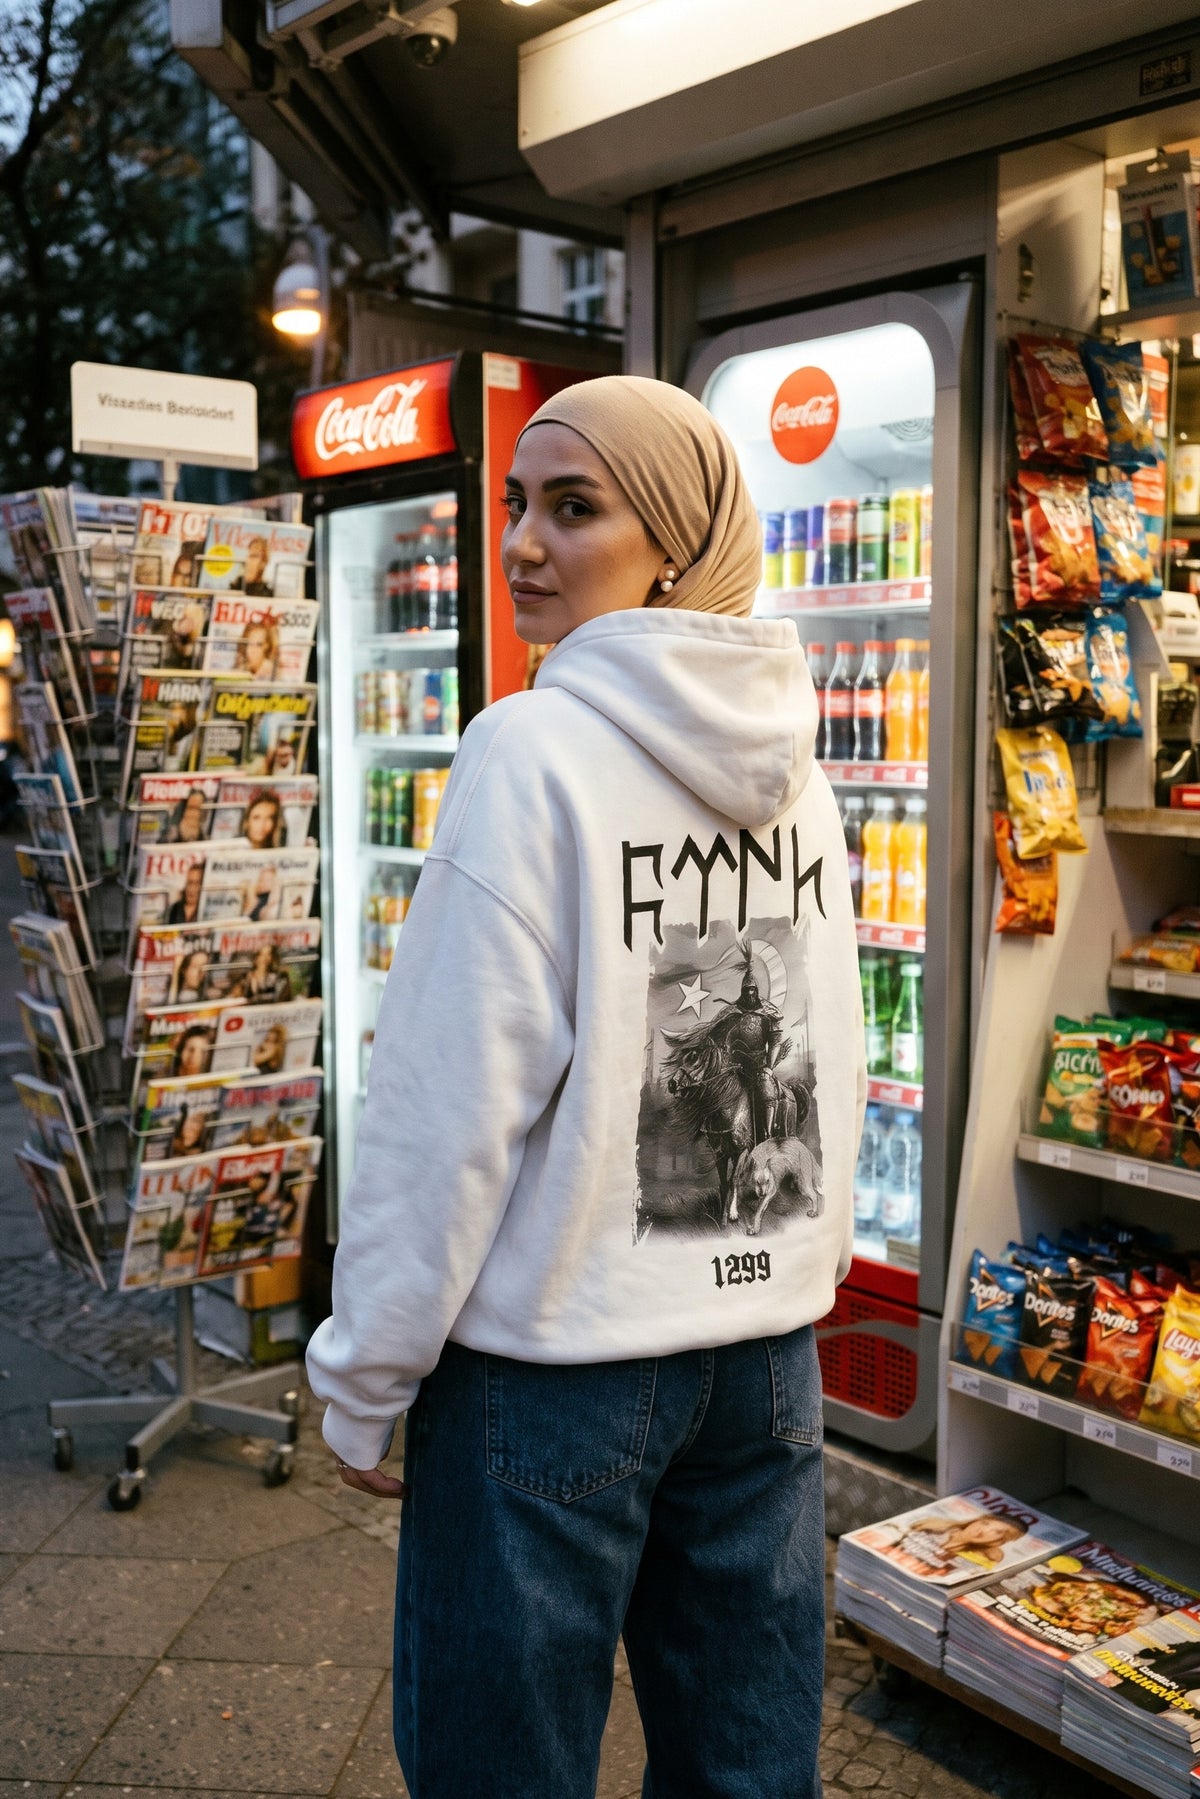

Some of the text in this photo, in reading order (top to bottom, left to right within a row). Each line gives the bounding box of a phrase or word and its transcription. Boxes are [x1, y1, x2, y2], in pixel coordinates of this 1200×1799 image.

[315, 379, 428, 461] Coca-Cola
[711, 1249, 771, 1289] 1299
[1024, 1291, 1076, 1321] Doritos
